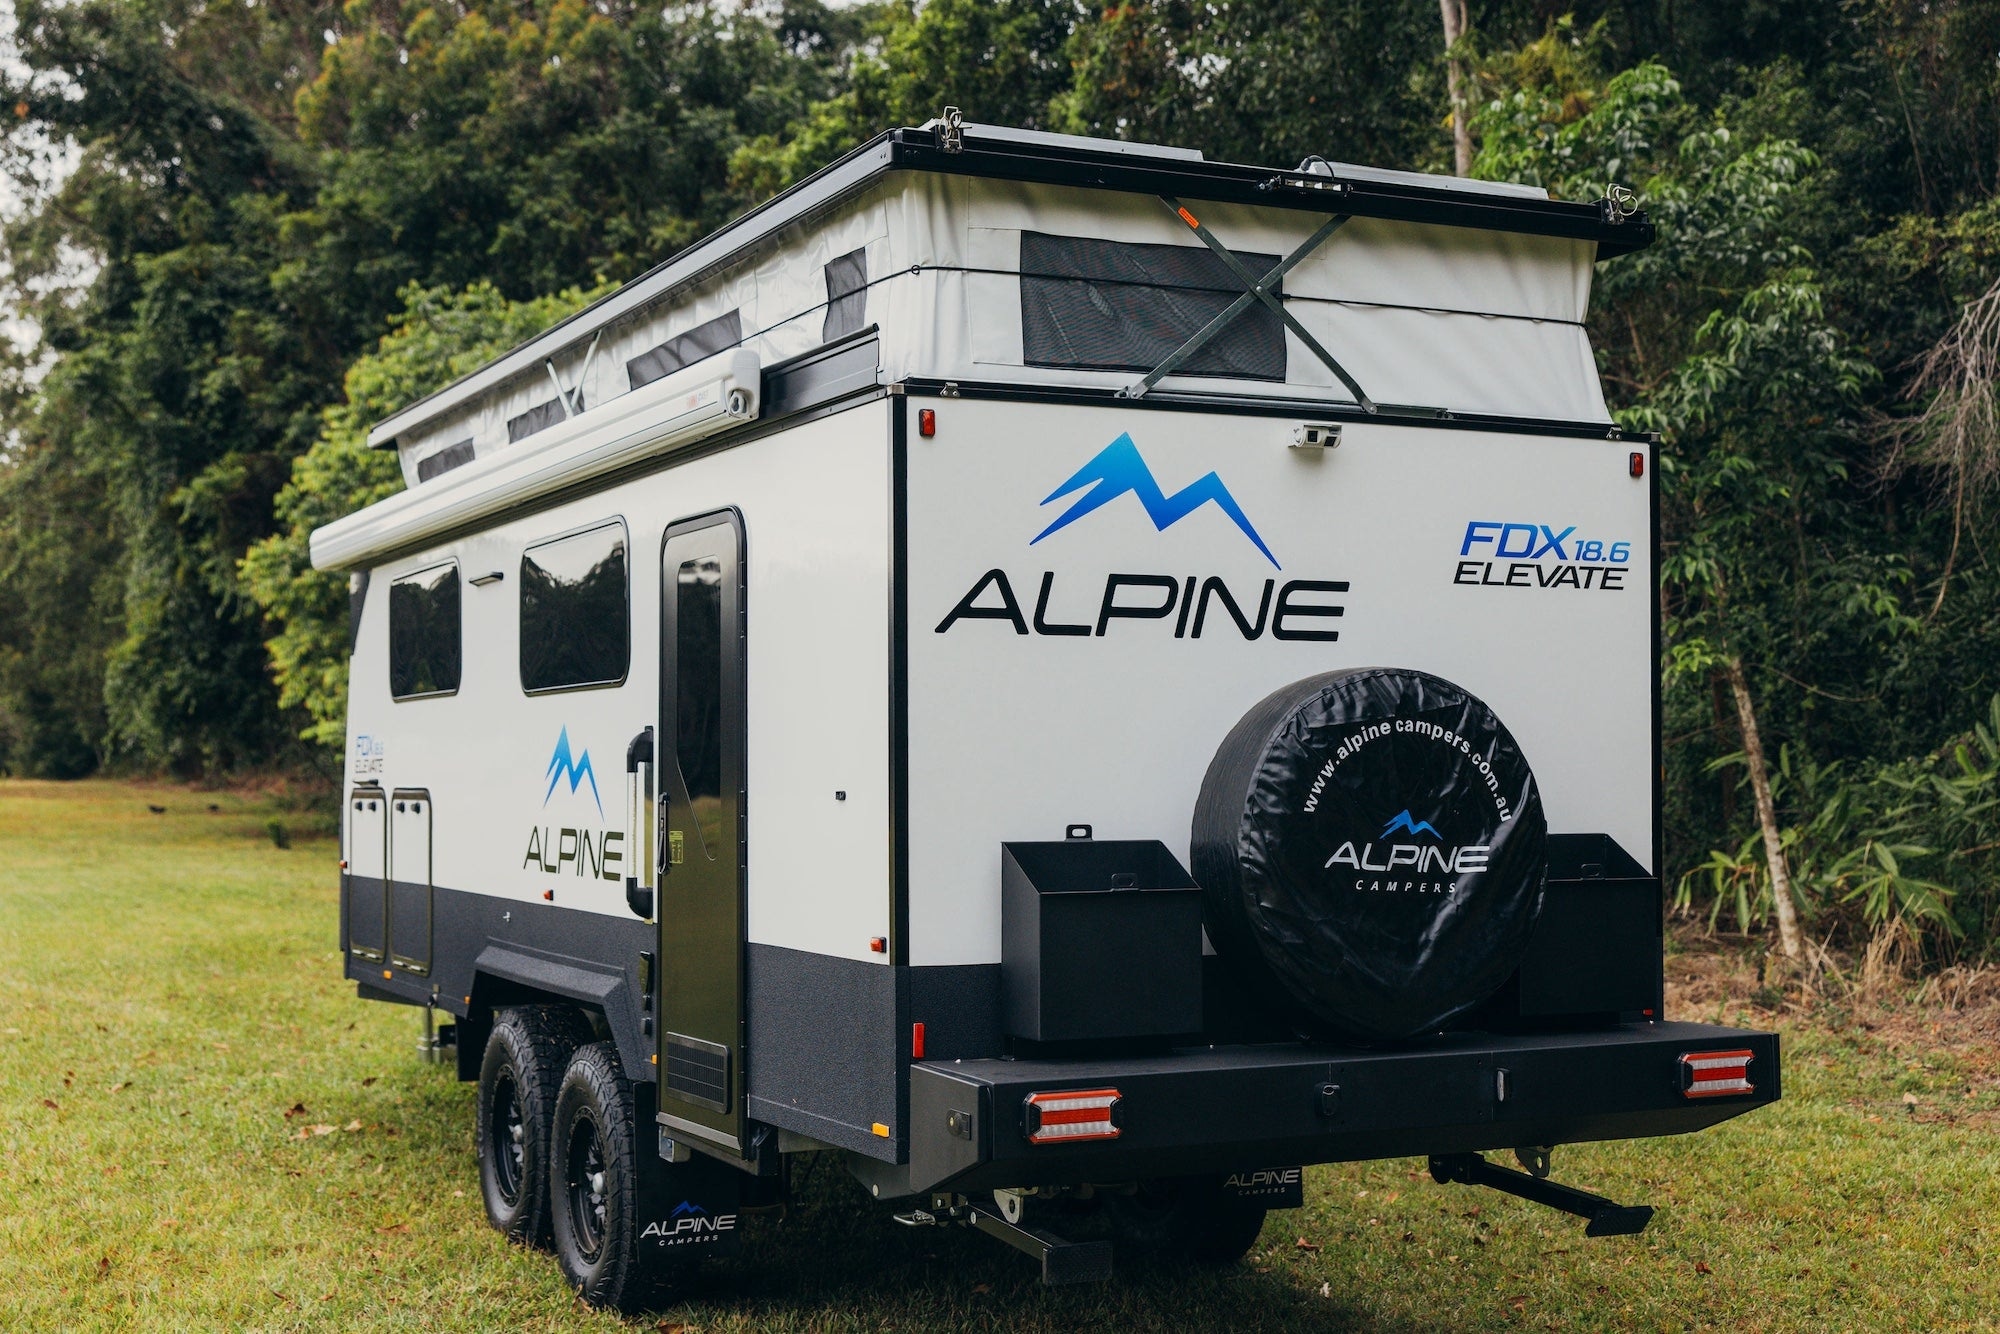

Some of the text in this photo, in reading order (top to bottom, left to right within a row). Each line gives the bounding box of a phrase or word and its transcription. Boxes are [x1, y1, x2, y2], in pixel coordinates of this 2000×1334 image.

[1460, 521, 1631, 563] FDX 18.6
[1453, 561, 1629, 590] ELEVATE
[934, 568, 1350, 641] ALPINE
[523, 825, 625, 882] ALPINE
[1324, 841, 1490, 874] ALPINE
[1355, 879, 1456, 893] CAMPERS
[1224, 1169, 1300, 1188] ALPINE
[1238, 1186, 1286, 1196] CAMPERS
[640, 1214, 737, 1239] ALPINE
[659, 1234, 719, 1247] CAMPERS
